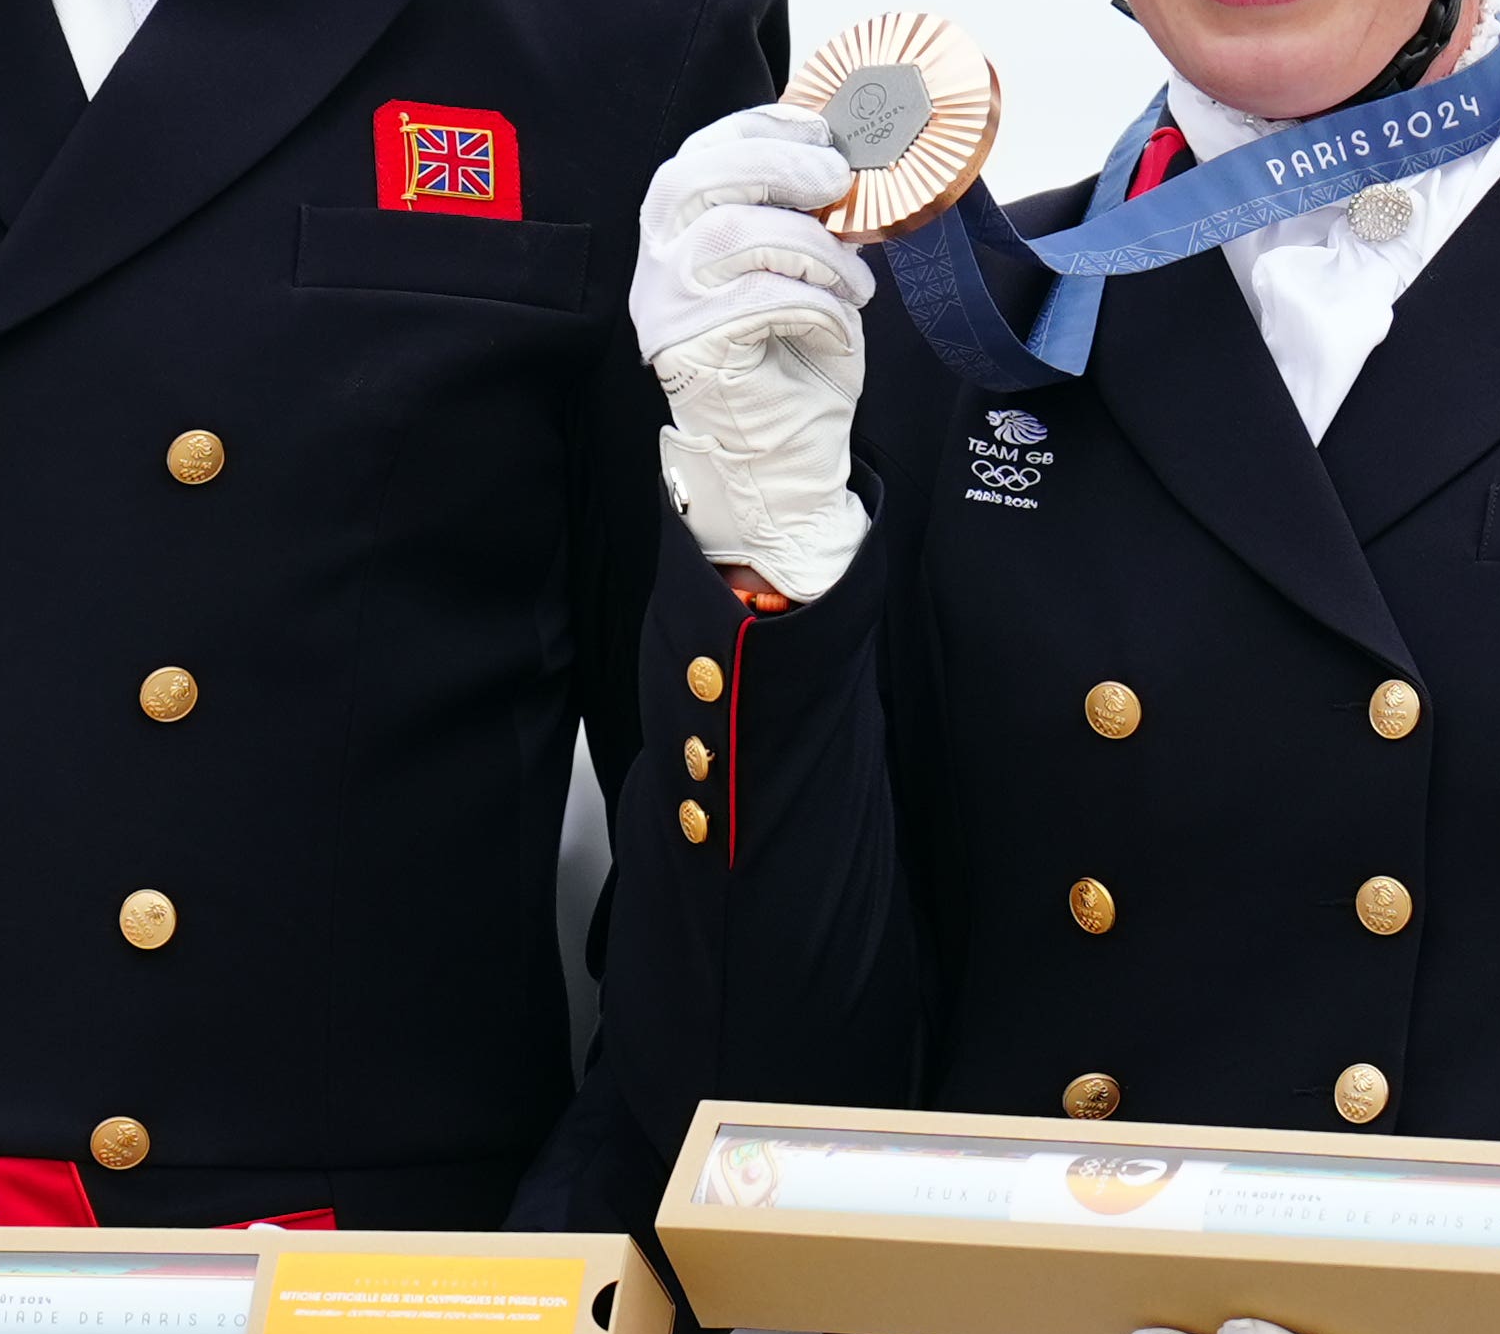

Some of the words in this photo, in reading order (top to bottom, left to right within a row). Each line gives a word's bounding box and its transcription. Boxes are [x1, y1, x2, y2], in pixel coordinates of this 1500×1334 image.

[1382, 95, 1480, 148] 2024
[968, 437, 1019, 461] TEAM
[1026, 451, 1054, 465] GB
[1004, 495, 1038, 509] 2024
[912, 1186, 968, 1201] JEUX
[1346, 1211, 1373, 1225] DE
[1392, 1213, 1464, 1229] PARIS
[20, 1296, 52, 1305] 2024
[79, 1311, 104, 1325] DE
[124, 1312, 198, 1327] PARIS
